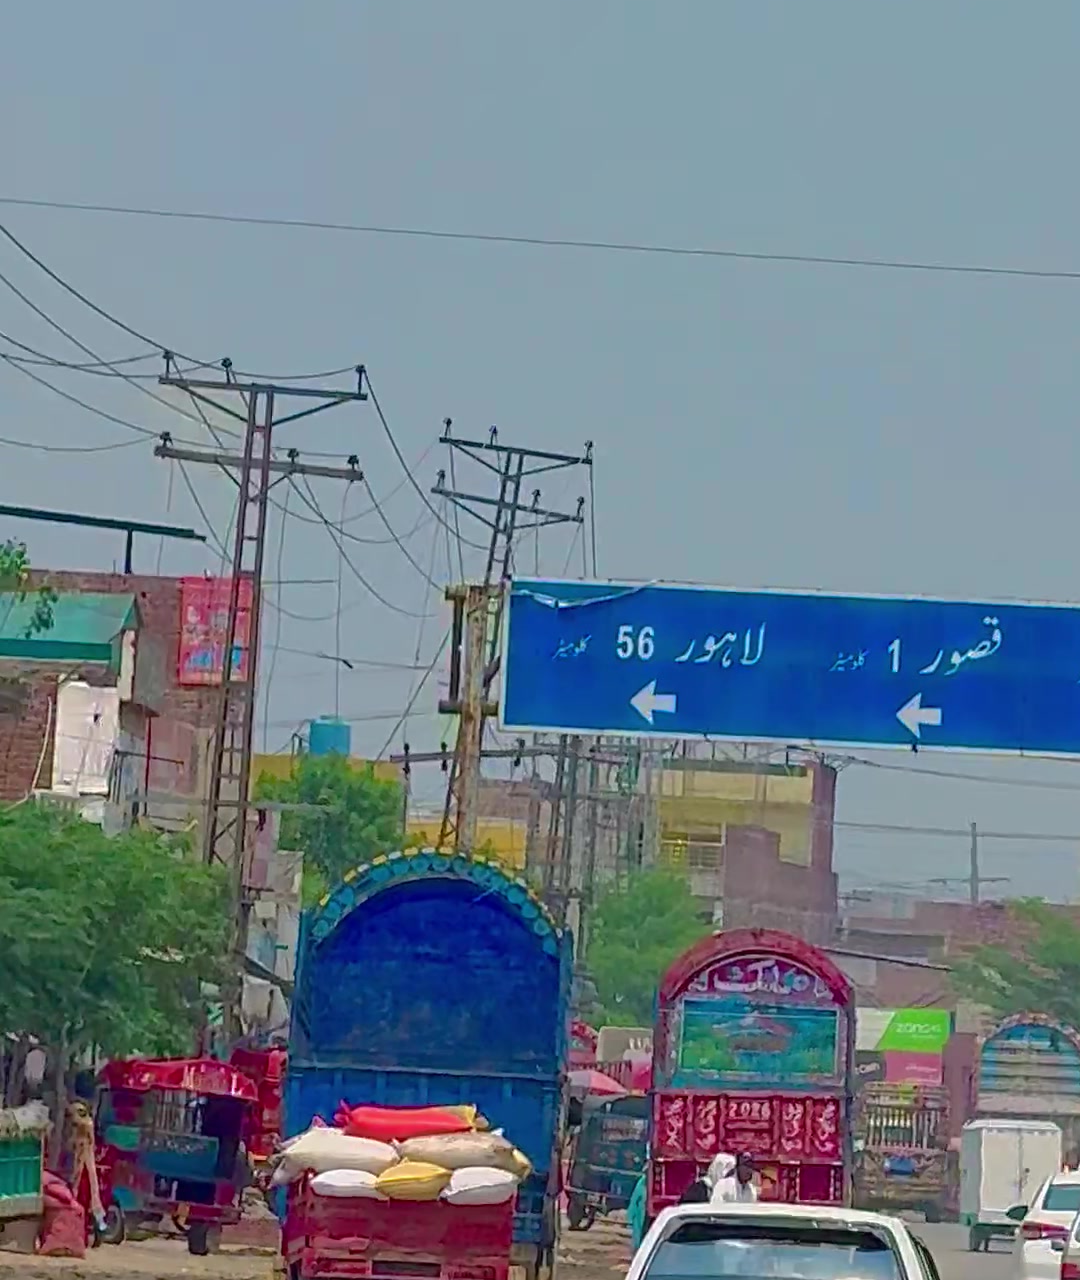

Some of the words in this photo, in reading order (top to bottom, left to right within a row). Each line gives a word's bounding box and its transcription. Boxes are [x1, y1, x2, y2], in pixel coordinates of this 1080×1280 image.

[616, 625, 655, 660] 56
[674, 622, 767, 668] لاہور
[888, 637, 901, 673] 1
[919, 616, 1002, 675] قصور
